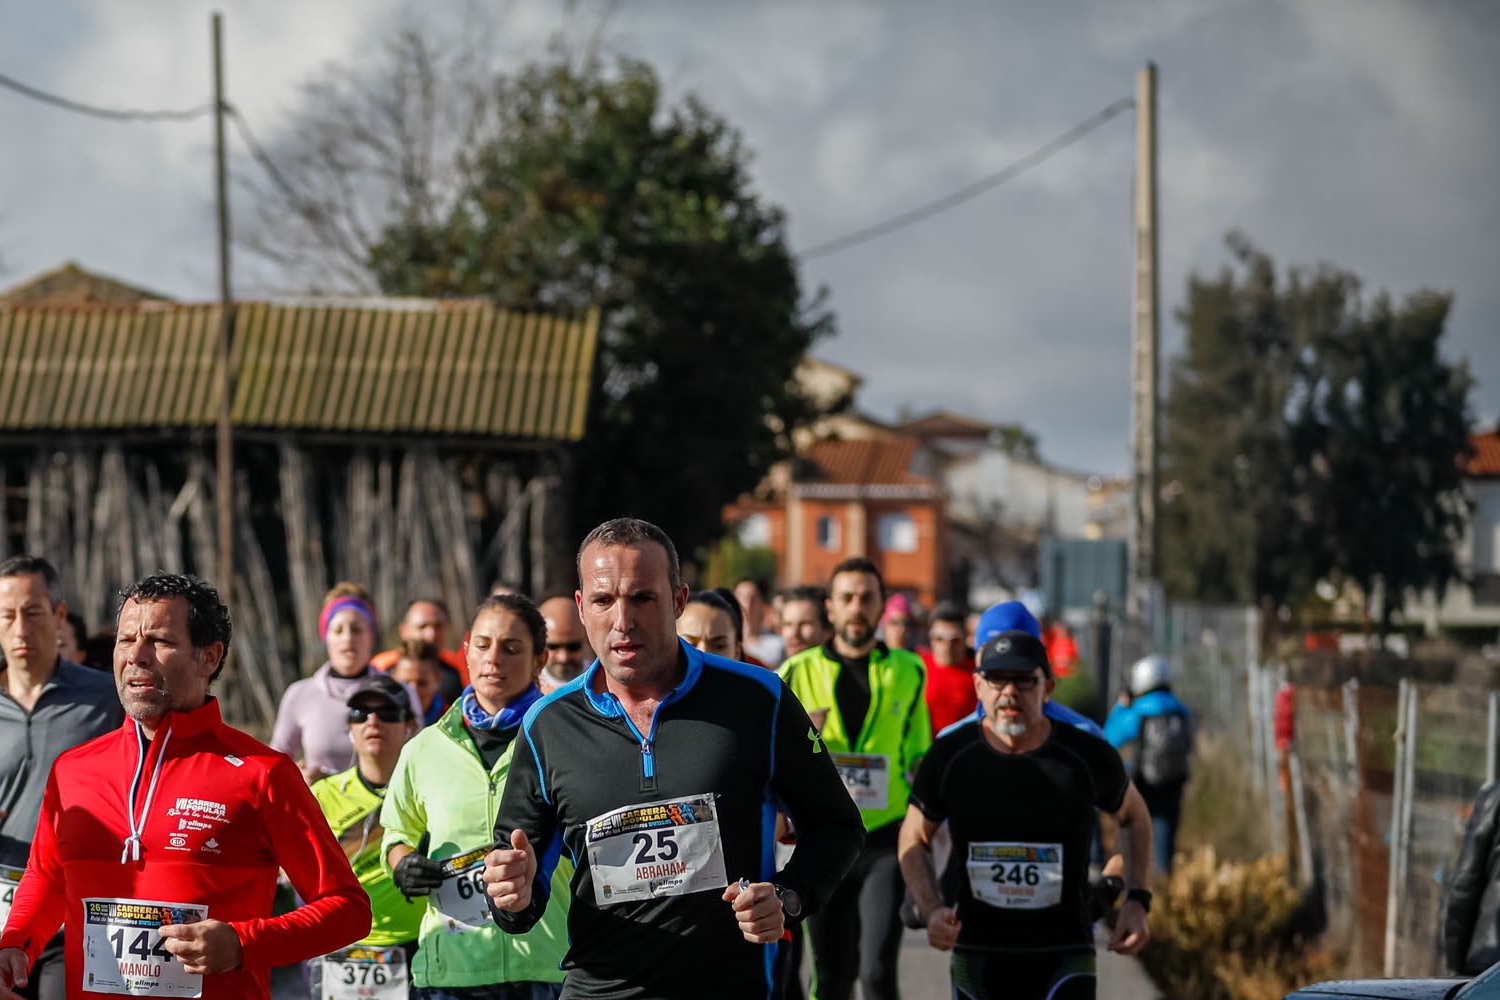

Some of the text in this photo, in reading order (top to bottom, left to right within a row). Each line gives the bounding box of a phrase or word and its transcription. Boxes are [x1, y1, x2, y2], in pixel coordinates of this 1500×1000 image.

[186, 804, 226, 817] POPULAR
[187, 799, 226, 810] CARRERA
[621, 806, 668, 820] CARRERA
[622, 813, 668, 827] POPULAR
[632, 830, 679, 864] 25
[636, 861, 688, 881] ABRAHAM
[991, 863, 1040, 886] 246
[90, 903, 101, 913] 26
[117, 904, 159, 914] CARRERA
[117, 912, 159, 920] POPULAR
[110, 928, 174, 962] 144
[120, 962, 161, 977] MANOLO
[343, 964, 386, 985] 376
[135, 979, 159, 988] olimpo
